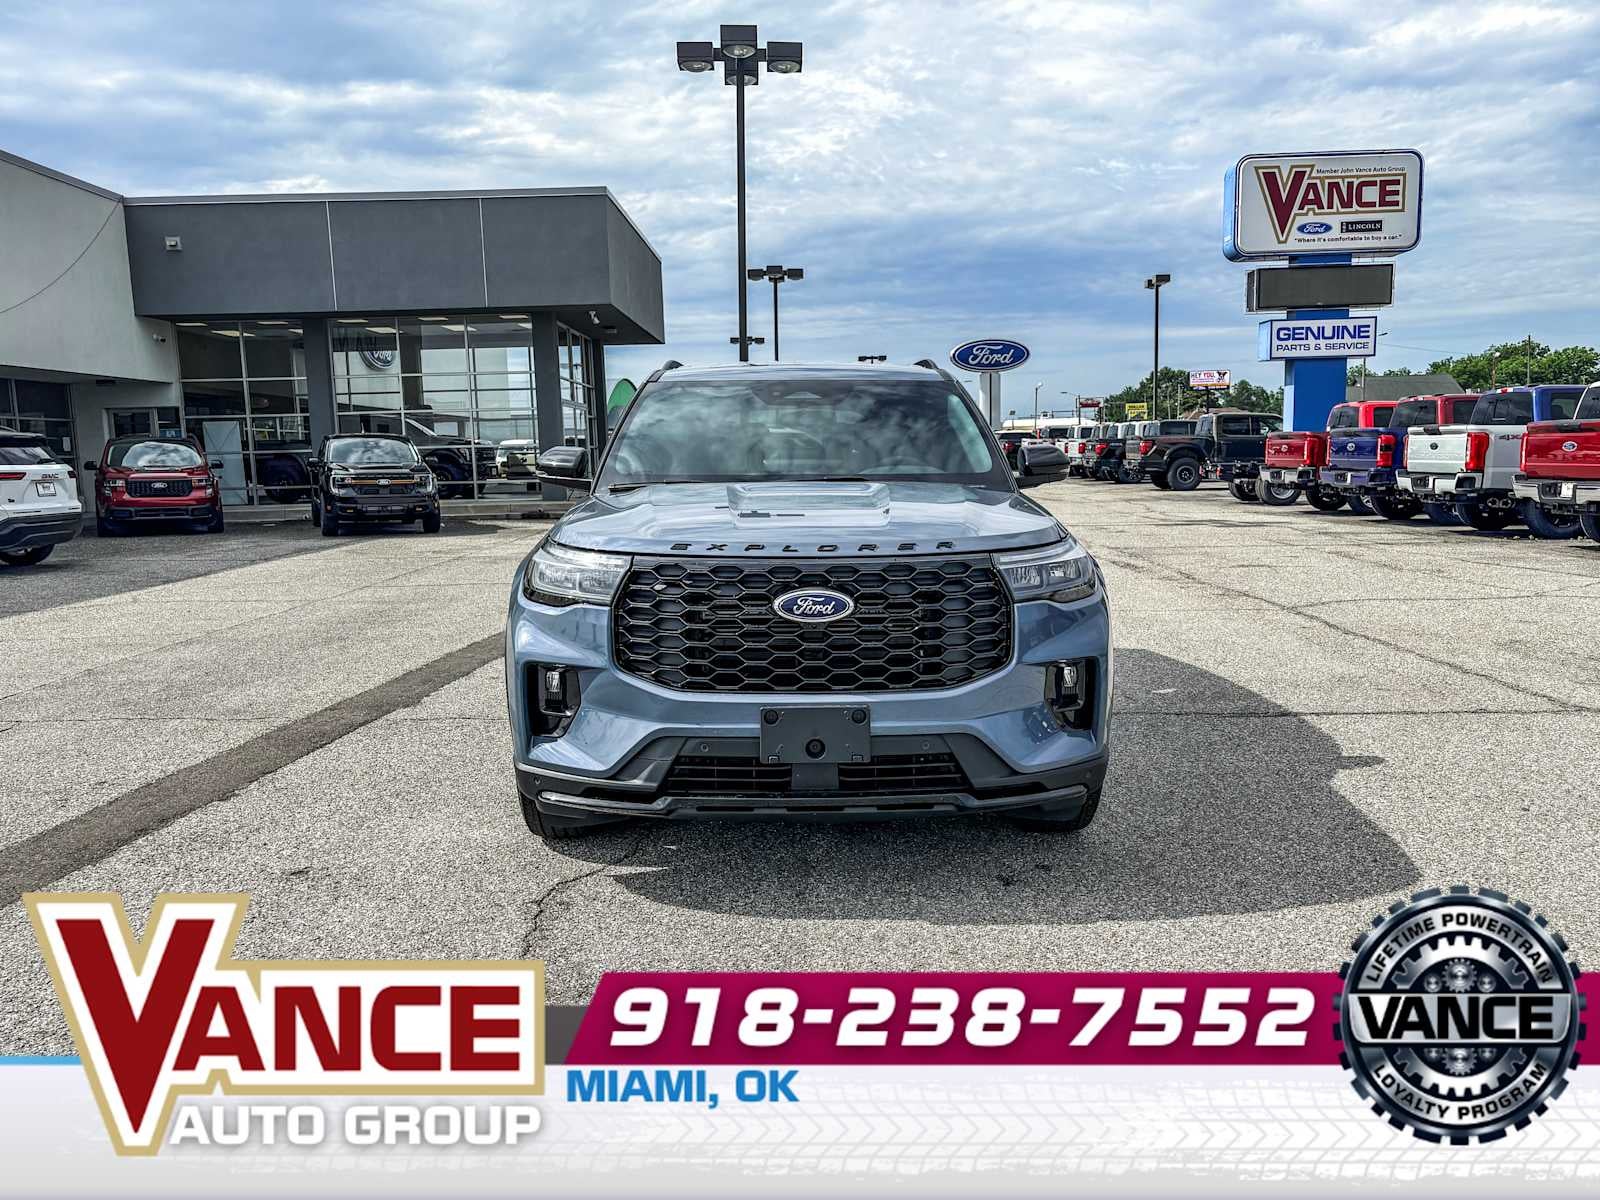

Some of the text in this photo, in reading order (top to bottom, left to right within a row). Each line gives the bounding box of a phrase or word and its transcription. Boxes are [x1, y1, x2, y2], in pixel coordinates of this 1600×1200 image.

[1261, 170, 1401, 238] VANCE
[1303, 223, 1326, 233] Ford
[1348, 223, 1382, 231] LINCOLN
[1276, 324, 1371, 342] GENUINE
[1276, 341, 1370, 352] PARTS & SERVICE
[968, 344, 1015, 365] Ford
[669, 540, 956, 552] EXPLORER
[793, 596, 836, 616] Ford
